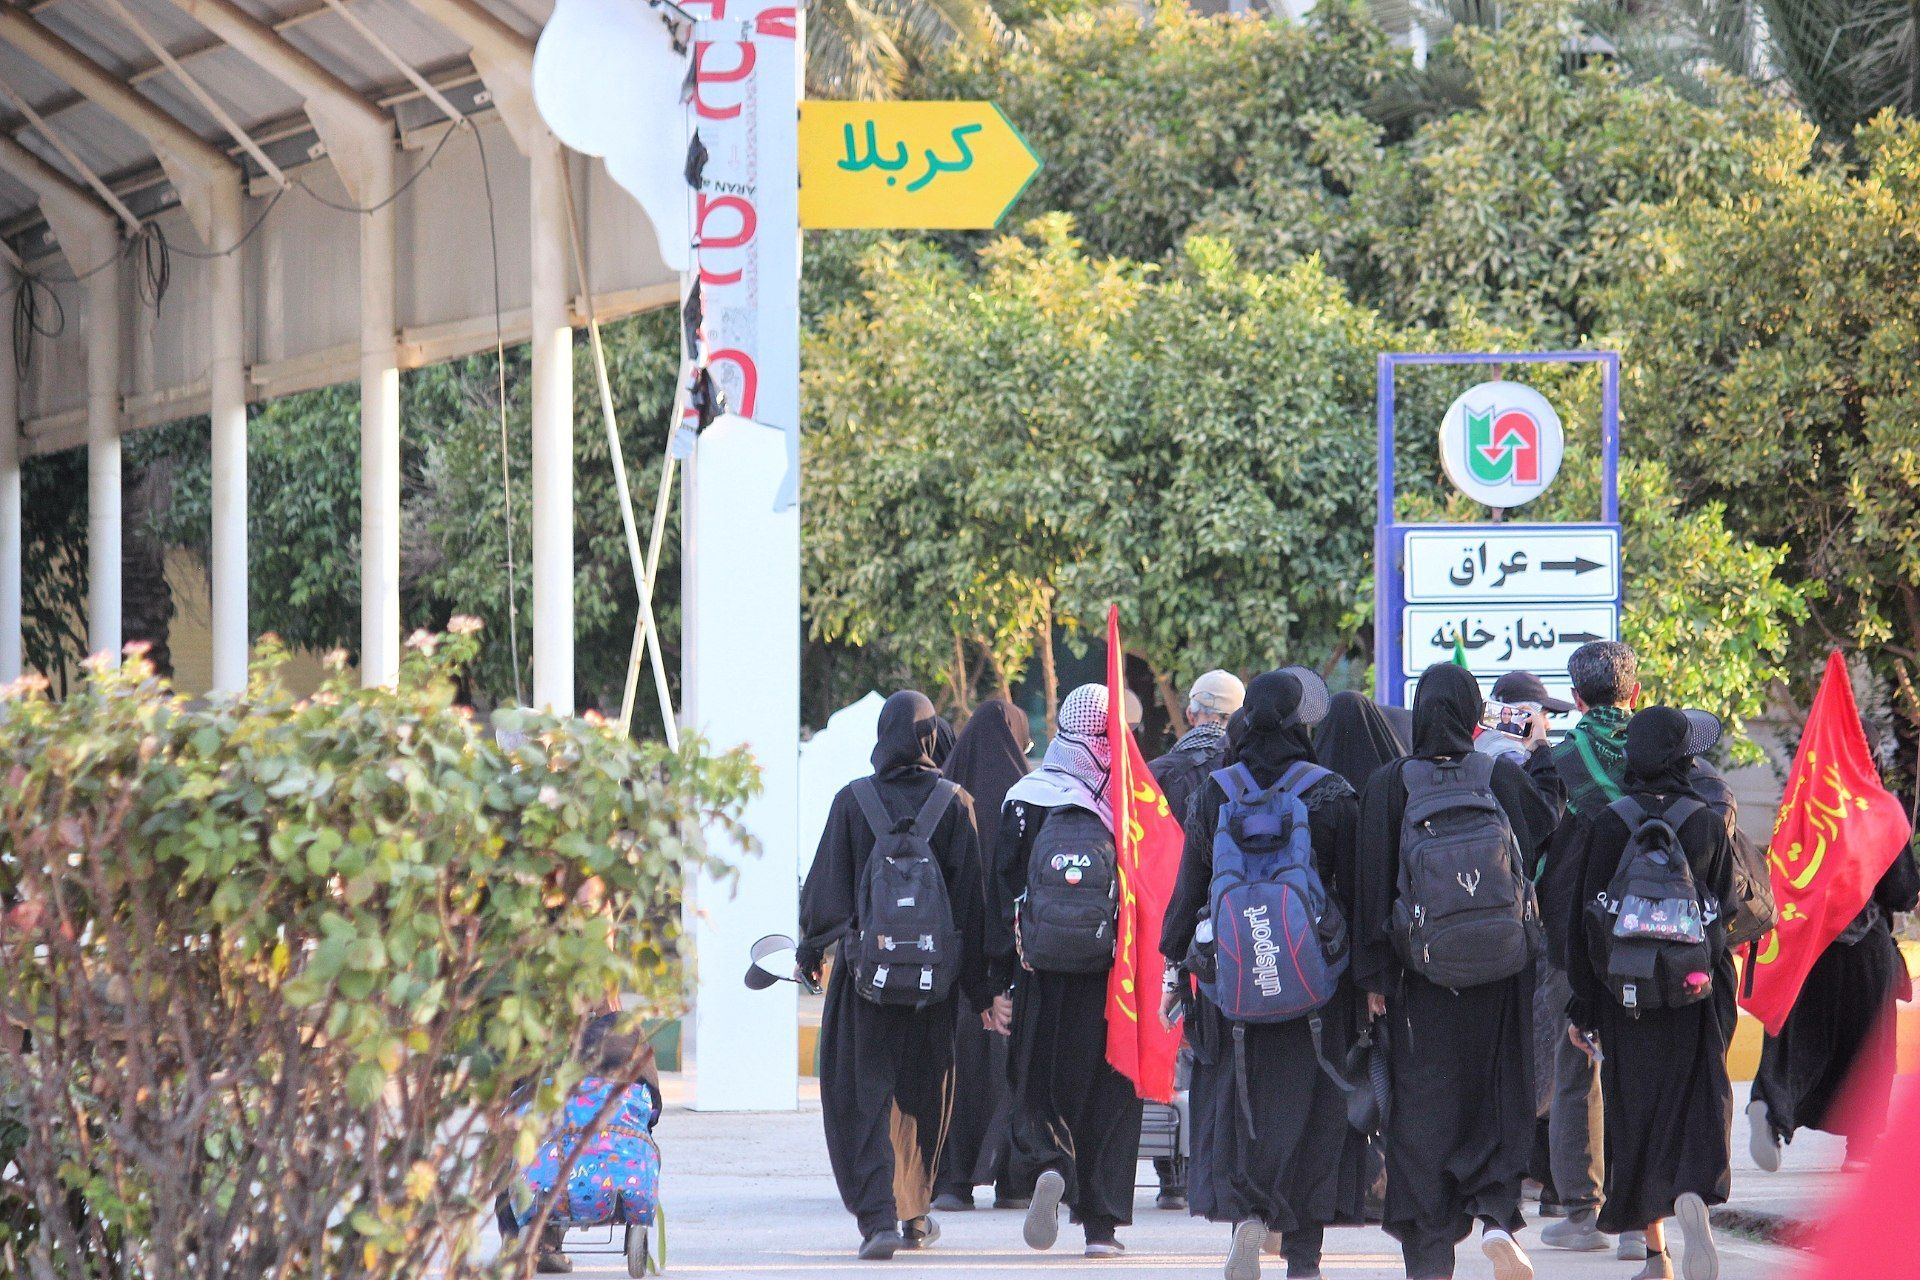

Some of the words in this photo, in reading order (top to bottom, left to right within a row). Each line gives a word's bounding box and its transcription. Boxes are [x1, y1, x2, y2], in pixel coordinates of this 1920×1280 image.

[837, 119, 983, 193] کربلا
[1449, 541, 1528, 588] عراق
[1242, 904, 1282, 997] uhlsport
